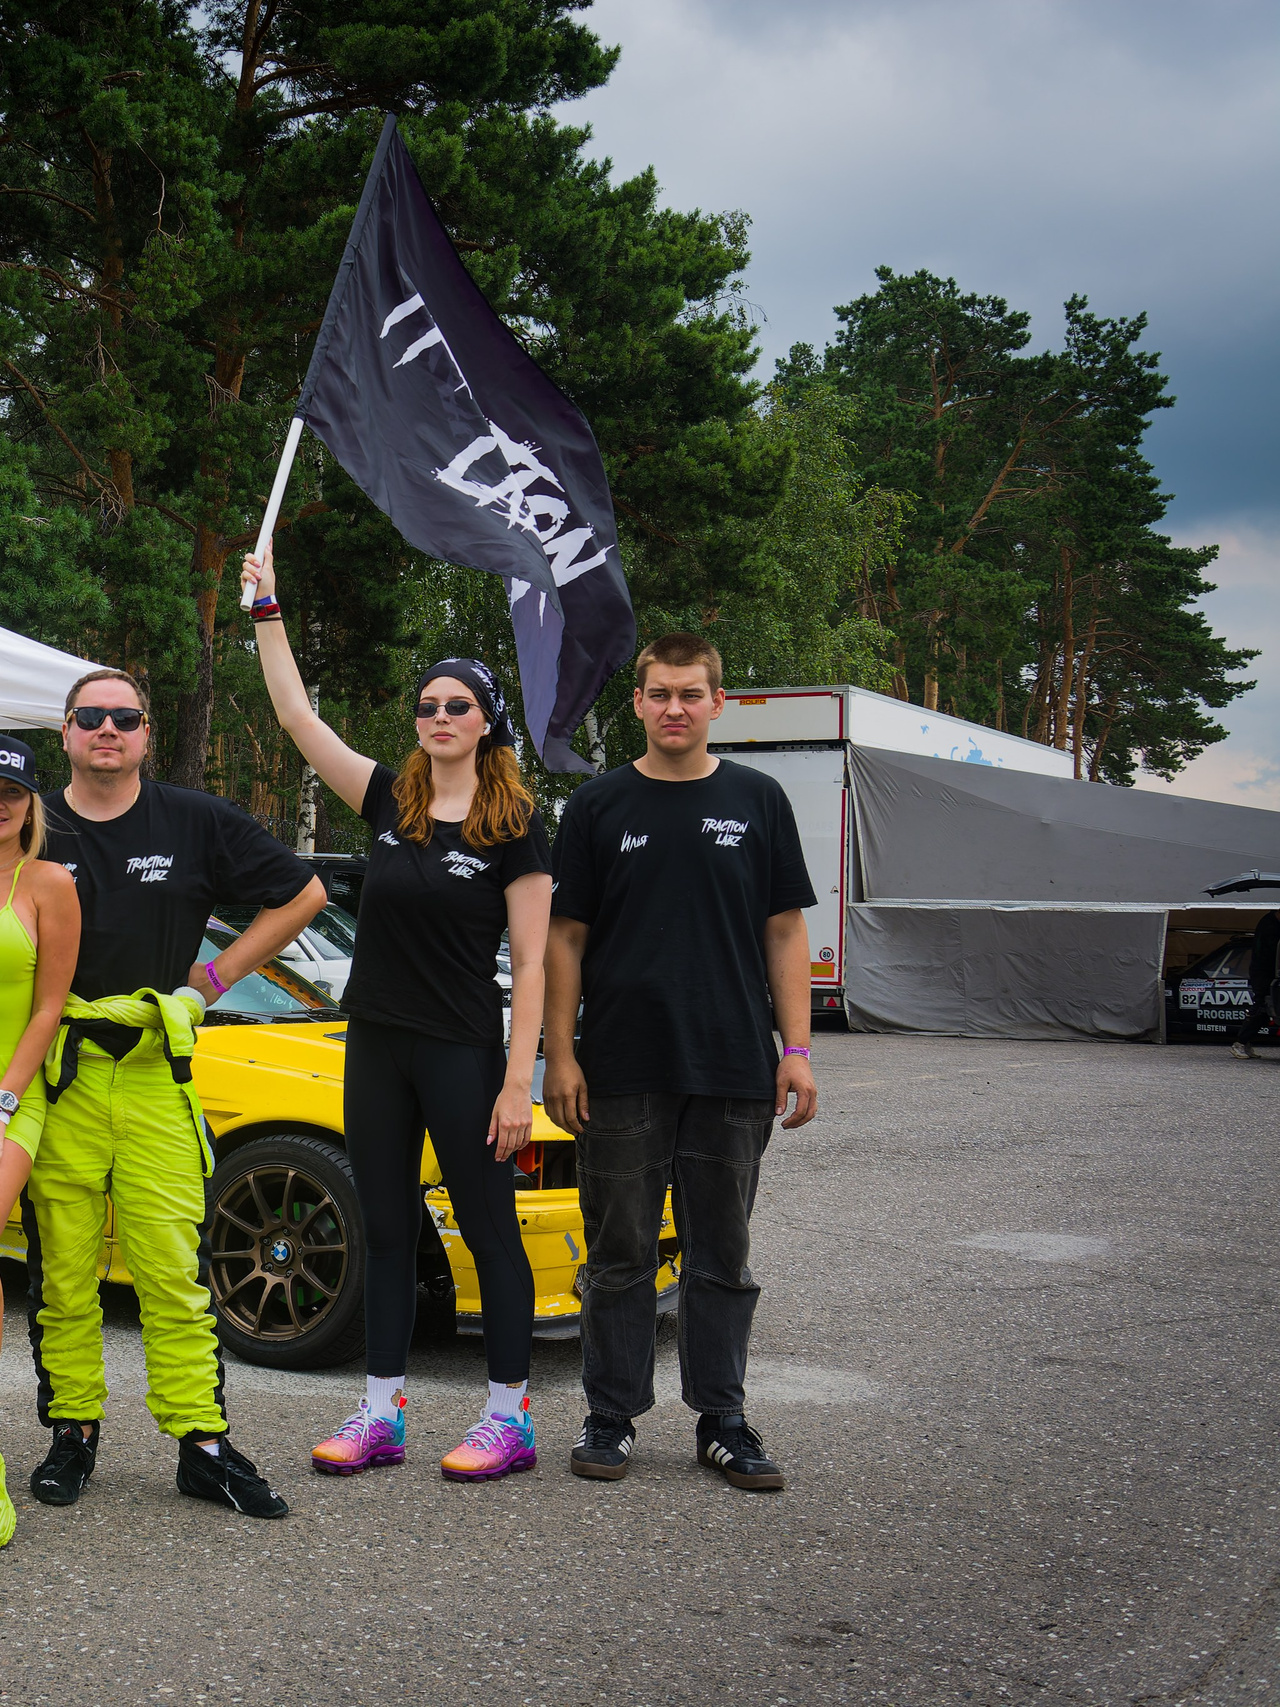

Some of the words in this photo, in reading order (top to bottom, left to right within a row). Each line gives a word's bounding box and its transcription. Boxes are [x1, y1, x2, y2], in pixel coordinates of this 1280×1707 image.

[701, 817, 749, 834] TRACTION
[714, 833, 743, 847] LABZ
[126, 855, 174, 874] TRACTION
[440, 850, 491, 872] TRACTION
[140, 870, 169, 883] LABZ
[448, 863, 476, 880] LABZ
[1182, 995, 1197, 1004] 82
[1201, 991, 1254, 1005] ADVA
[1197, 1009, 1246, 1020] PROGRES
[1197, 1024, 1227, 1032] BILSTEIN
